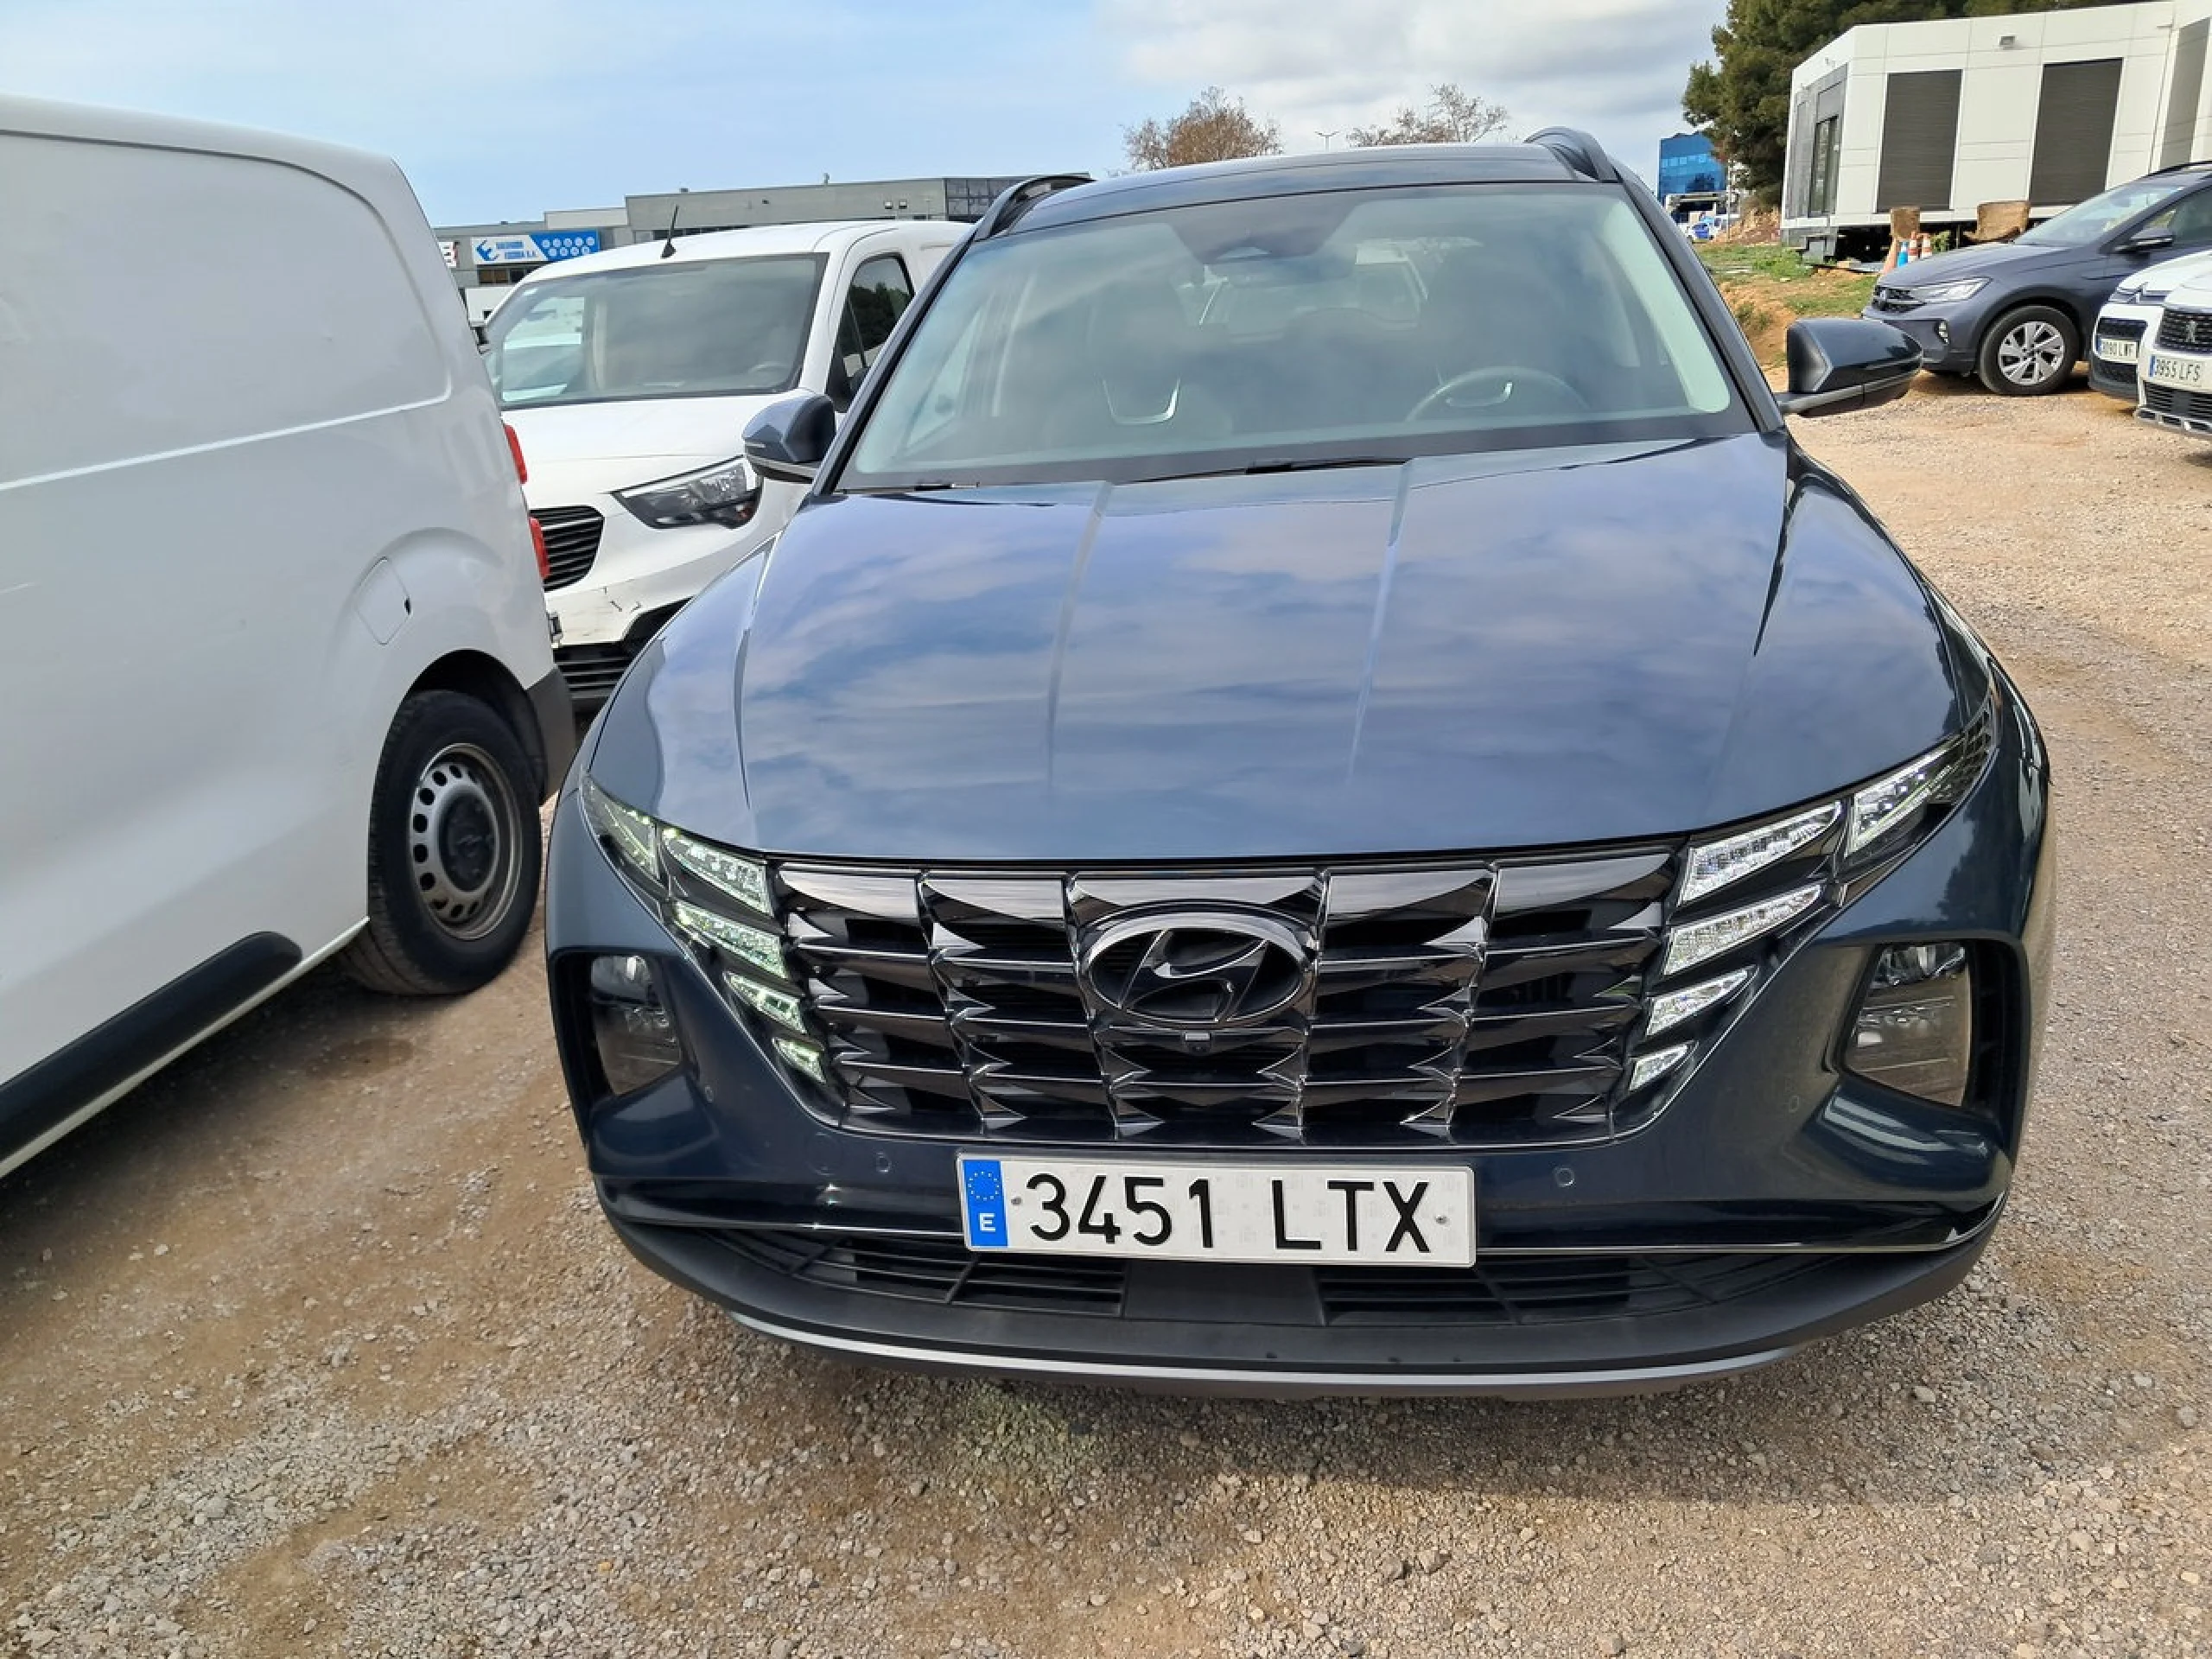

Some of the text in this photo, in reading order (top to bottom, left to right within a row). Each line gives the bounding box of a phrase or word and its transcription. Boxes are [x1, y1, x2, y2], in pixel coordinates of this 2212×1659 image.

[2178, 362, 2201, 382] LFS
[978, 1212, 996, 1233] E
[1026, 1173, 1431, 1253] 3451 LTX
